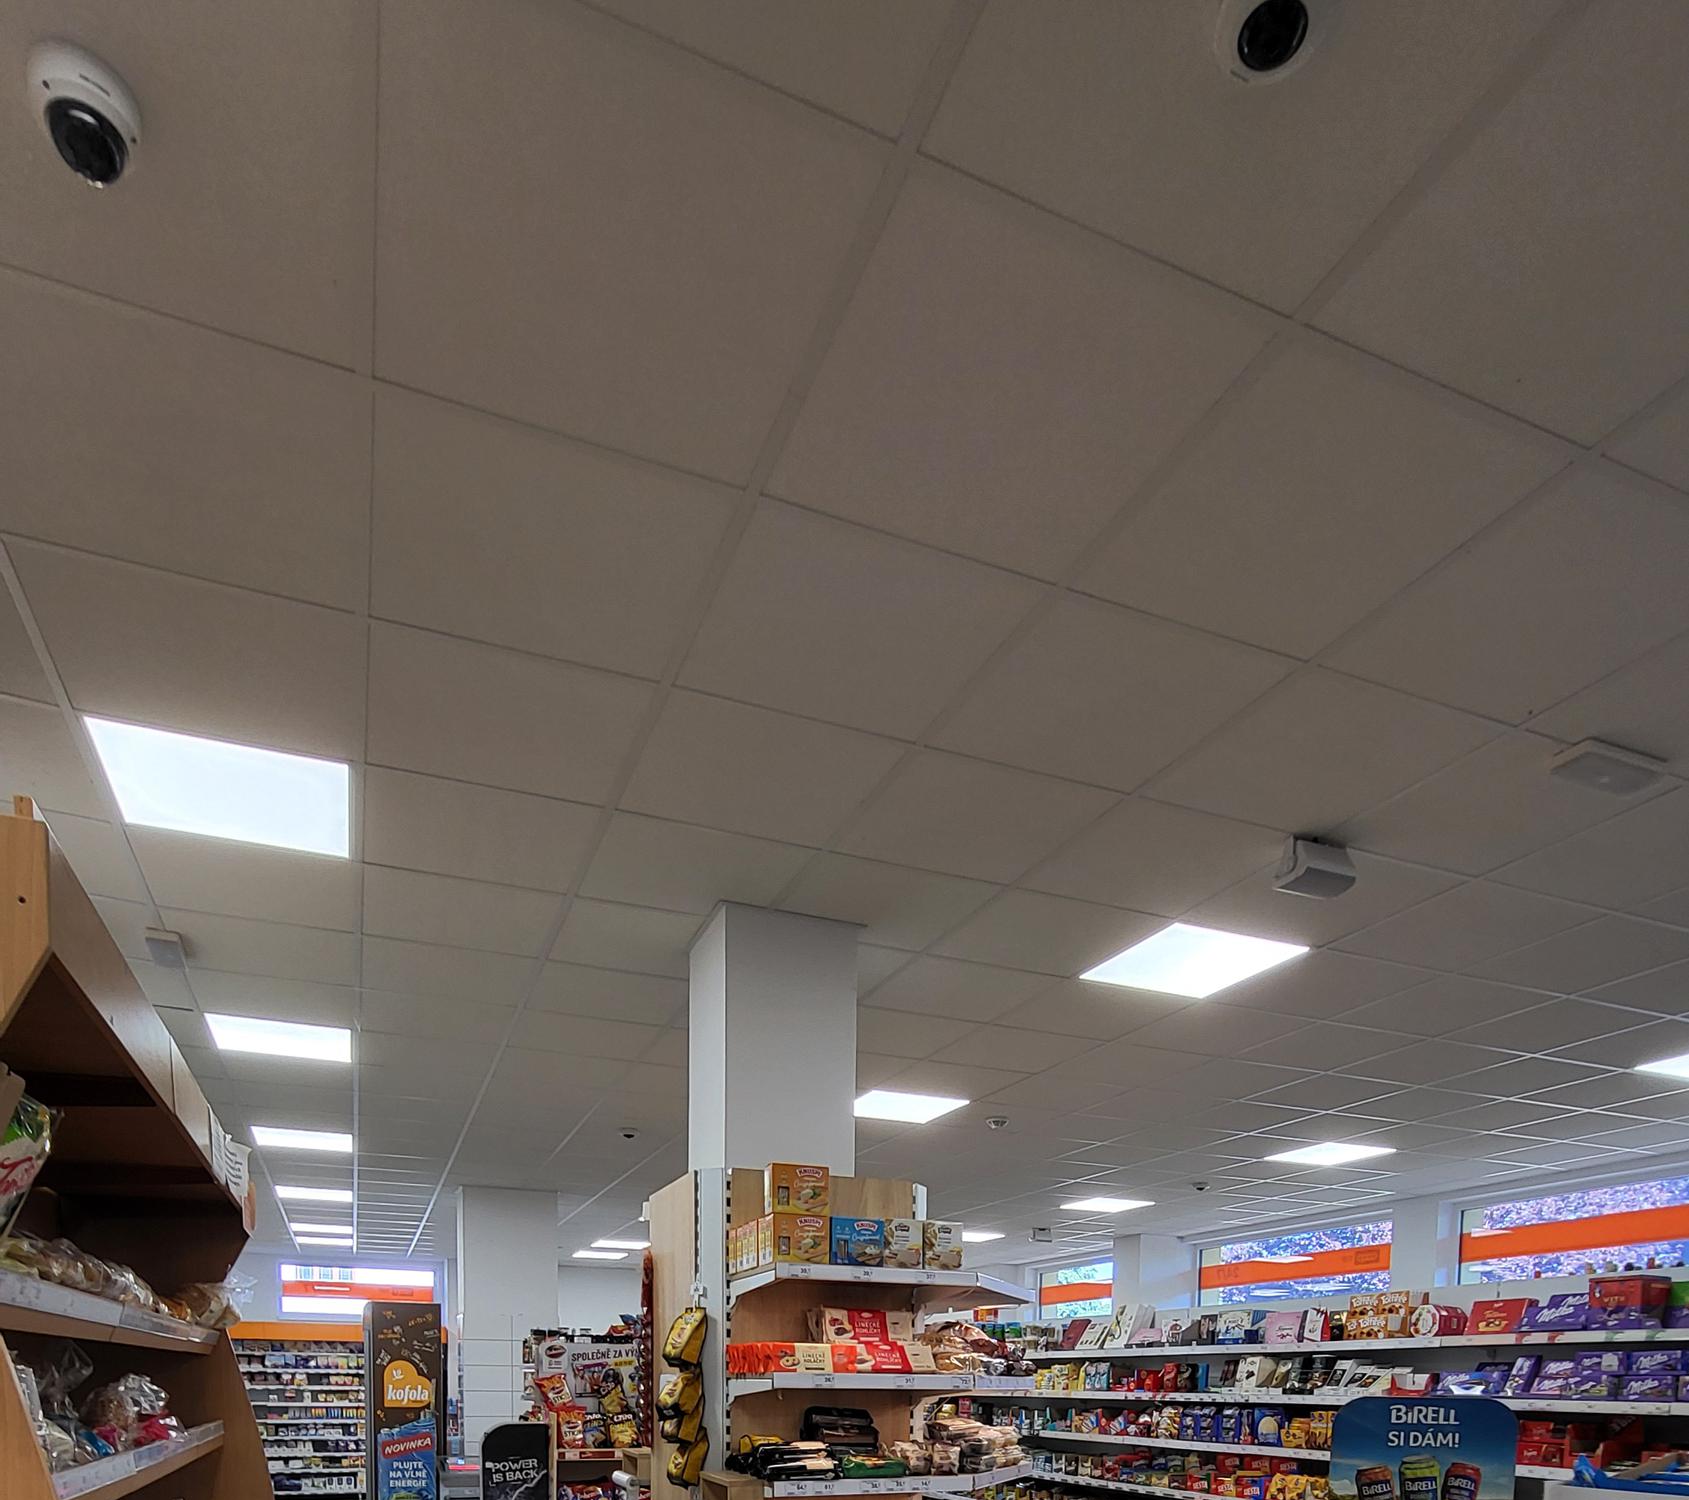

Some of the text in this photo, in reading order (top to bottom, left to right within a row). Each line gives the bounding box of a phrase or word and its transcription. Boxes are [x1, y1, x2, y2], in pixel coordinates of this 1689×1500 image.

[571, 1348, 611, 1361] SPOLEČNĚ
[613, 1350, 623, 1358] ZA
[387, 1385, 429, 1405] kofola
[1388, 1428, 1460, 1448] SI DÁM!
[384, 1437, 432, 1455] NOVINKA
[393, 1461, 424, 1469] PLUJTE
[491, 1458, 538, 1472] POWER
[390, 1468, 428, 1479] NA VLNĚ
[493, 1468, 539, 1482] IS BACK
[389, 1479, 428, 1487] ENERGIE
